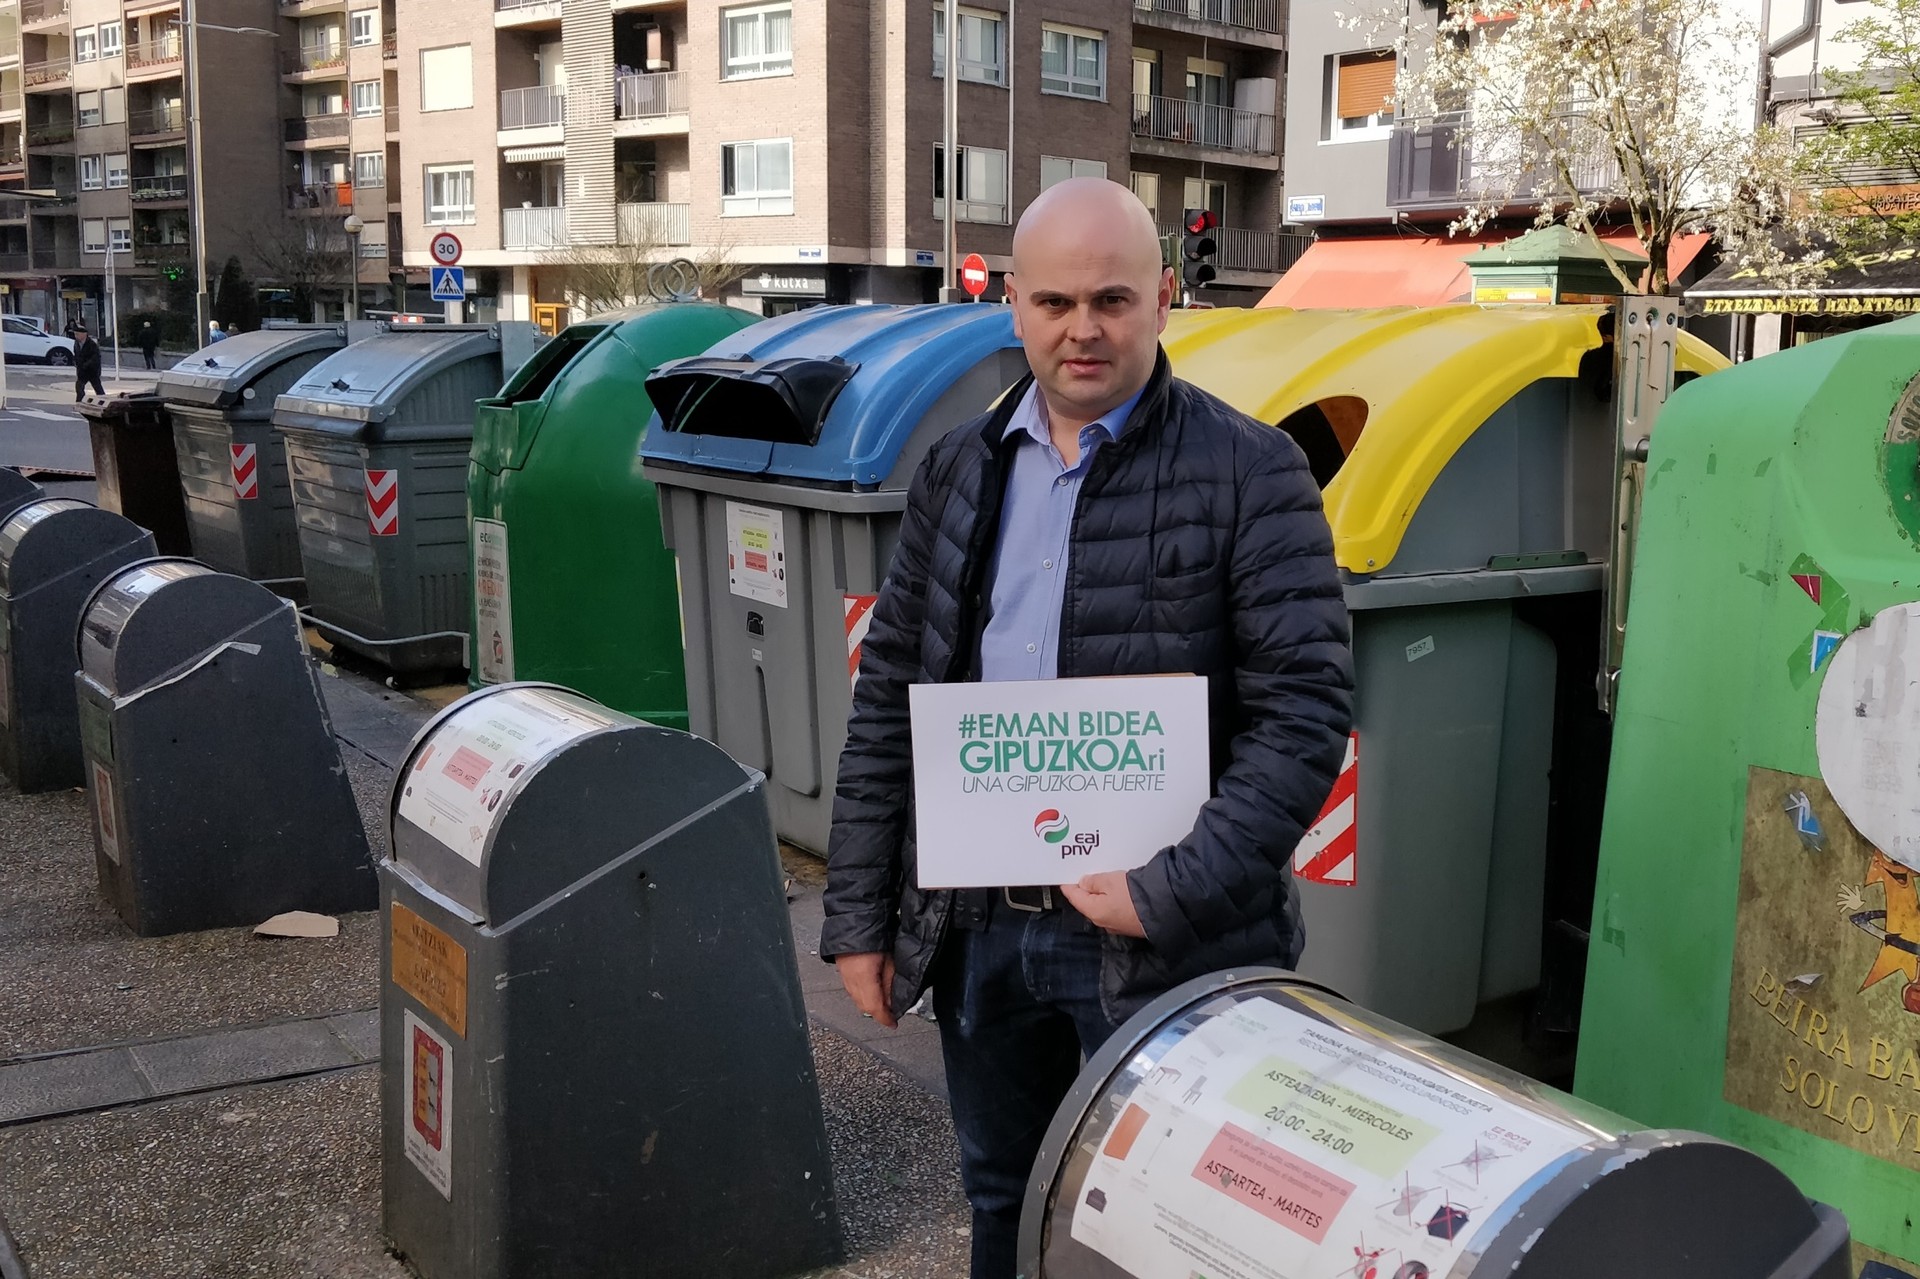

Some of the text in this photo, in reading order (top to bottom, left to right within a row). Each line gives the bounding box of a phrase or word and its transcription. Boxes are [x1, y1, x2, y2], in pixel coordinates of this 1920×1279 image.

[438, 243, 455, 255] 30
[774, 273, 809, 289] kutxa
[958, 710, 1165, 739] #EMAN BIDEA
[959, 738, 1166, 774] GIPUZKOAri
[962, 774, 1166, 793] UNA GIPUZKOA FUERTE
[1061, 844, 1093, 860] pnv
[1074, 829, 1100, 848] eaj
[1750, 966, 1854, 1070] BEIRA
[1264, 1069, 1337, 1107] ASTEAZKENA
[1779, 1055, 1876, 1134] SOLO
[1264, 1106, 1306, 1133] 20:00
[1311, 1128, 1355, 1156] 24:00
[1272, 1196, 1323, 1230] MARTES
